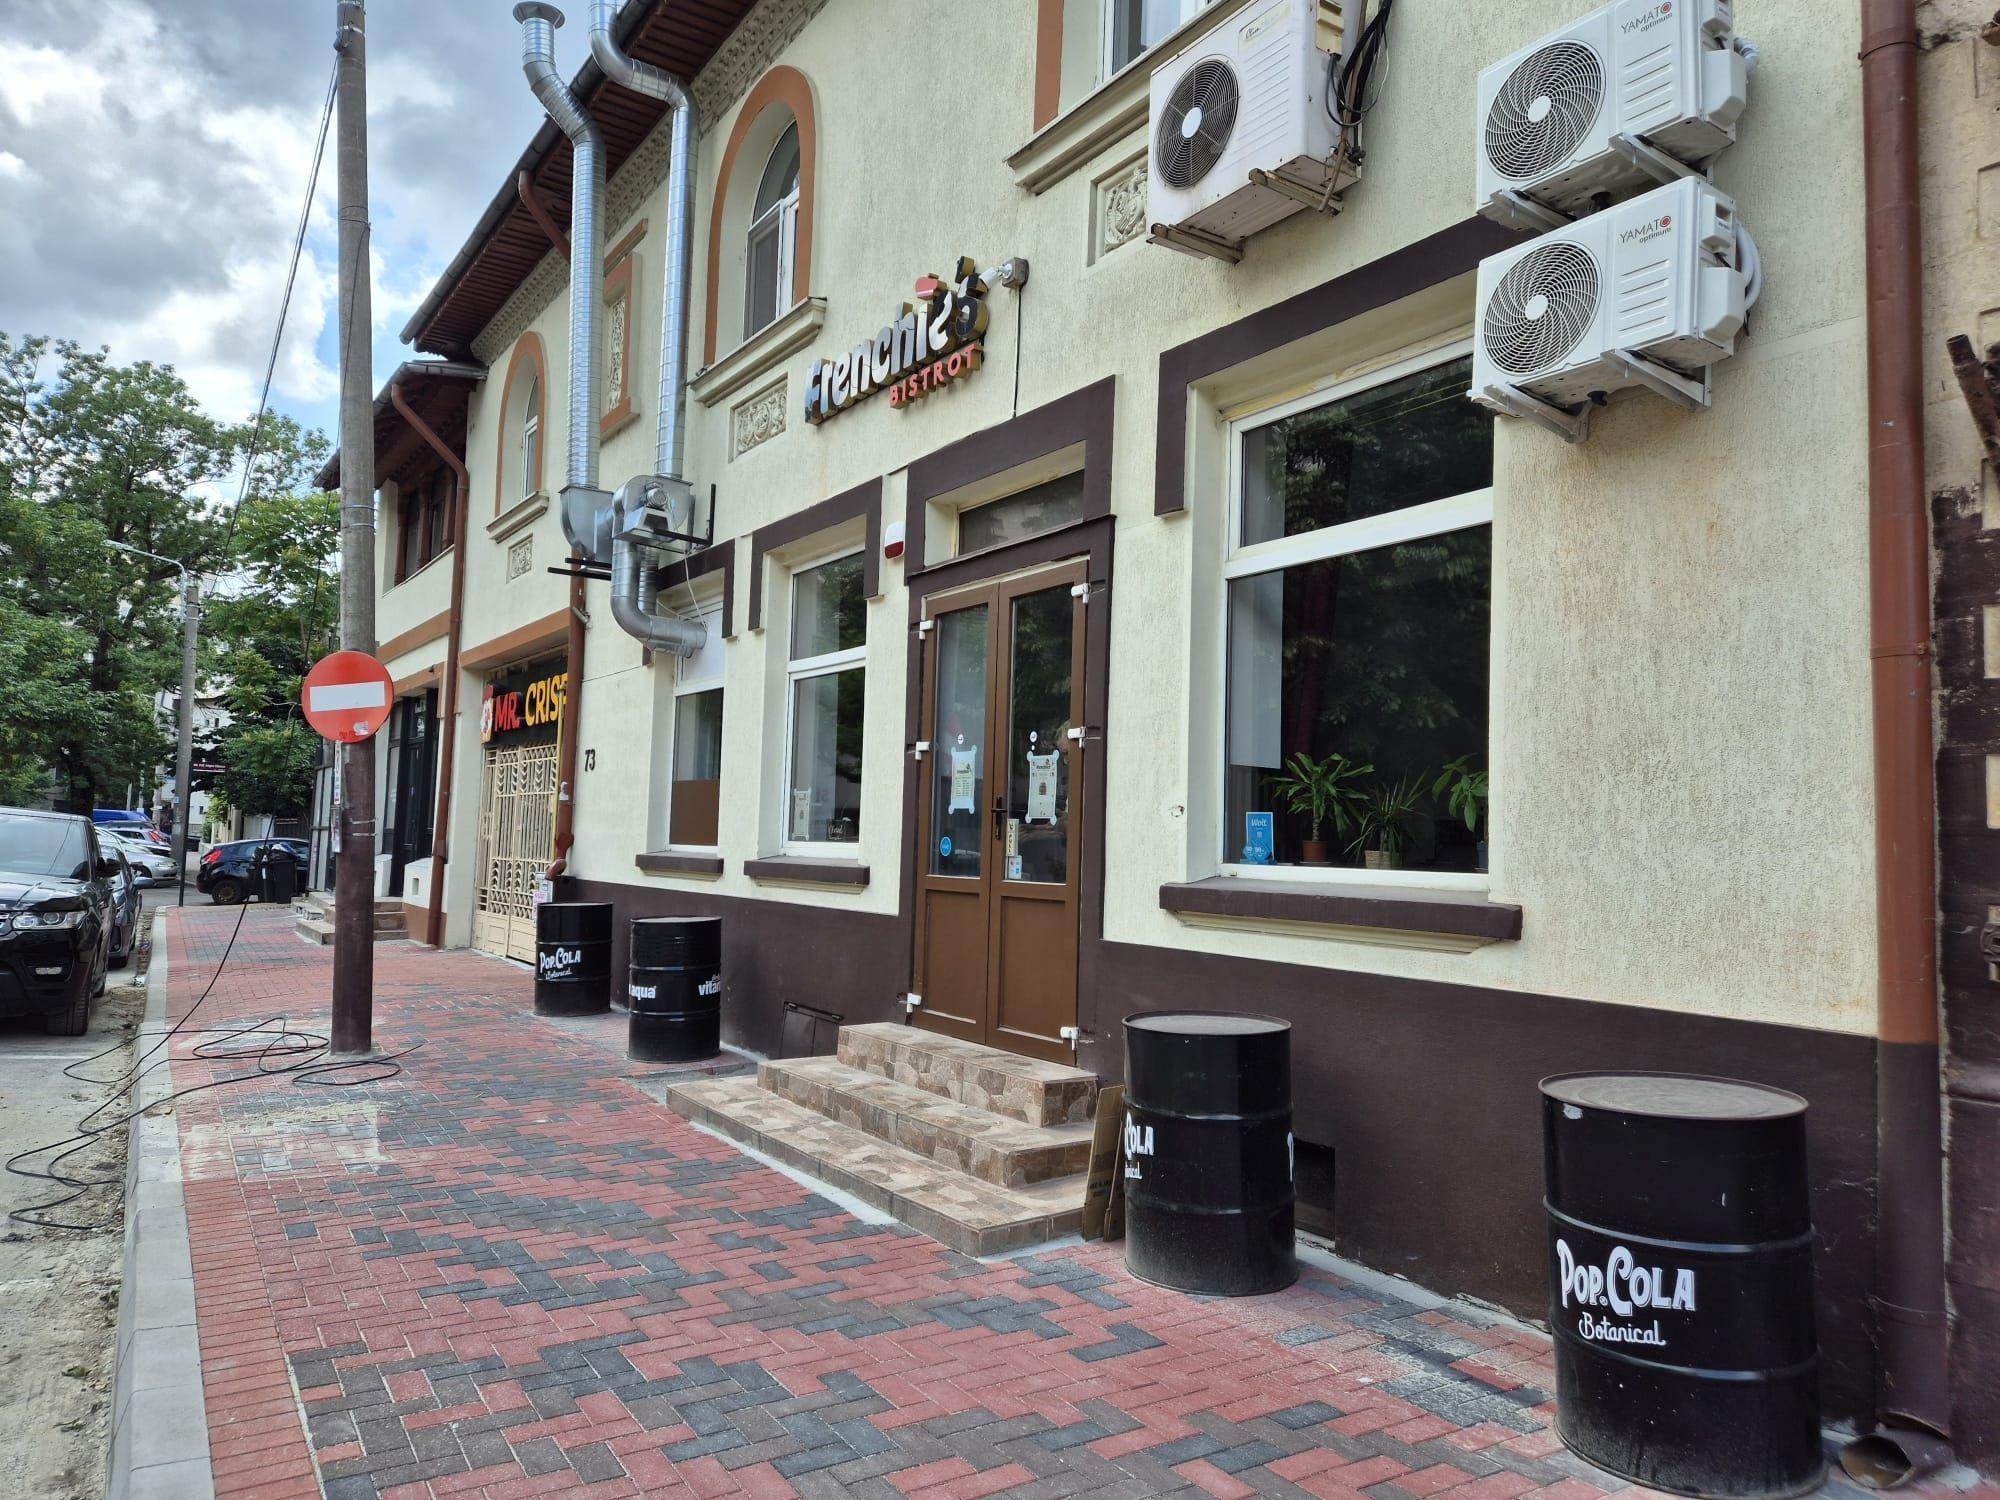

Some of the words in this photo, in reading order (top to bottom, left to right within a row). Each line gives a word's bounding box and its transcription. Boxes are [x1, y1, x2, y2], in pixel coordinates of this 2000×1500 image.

[1620, 1, 1672, 34] YAMATO
[1620, 215, 1671, 243] YAMATO
[1639, 227, 1671, 243] optimum
[889, 343, 977, 406] BISTROT
[584, 748, 596, 772] 73
[1578, 1311, 1667, 1346] Botanical
